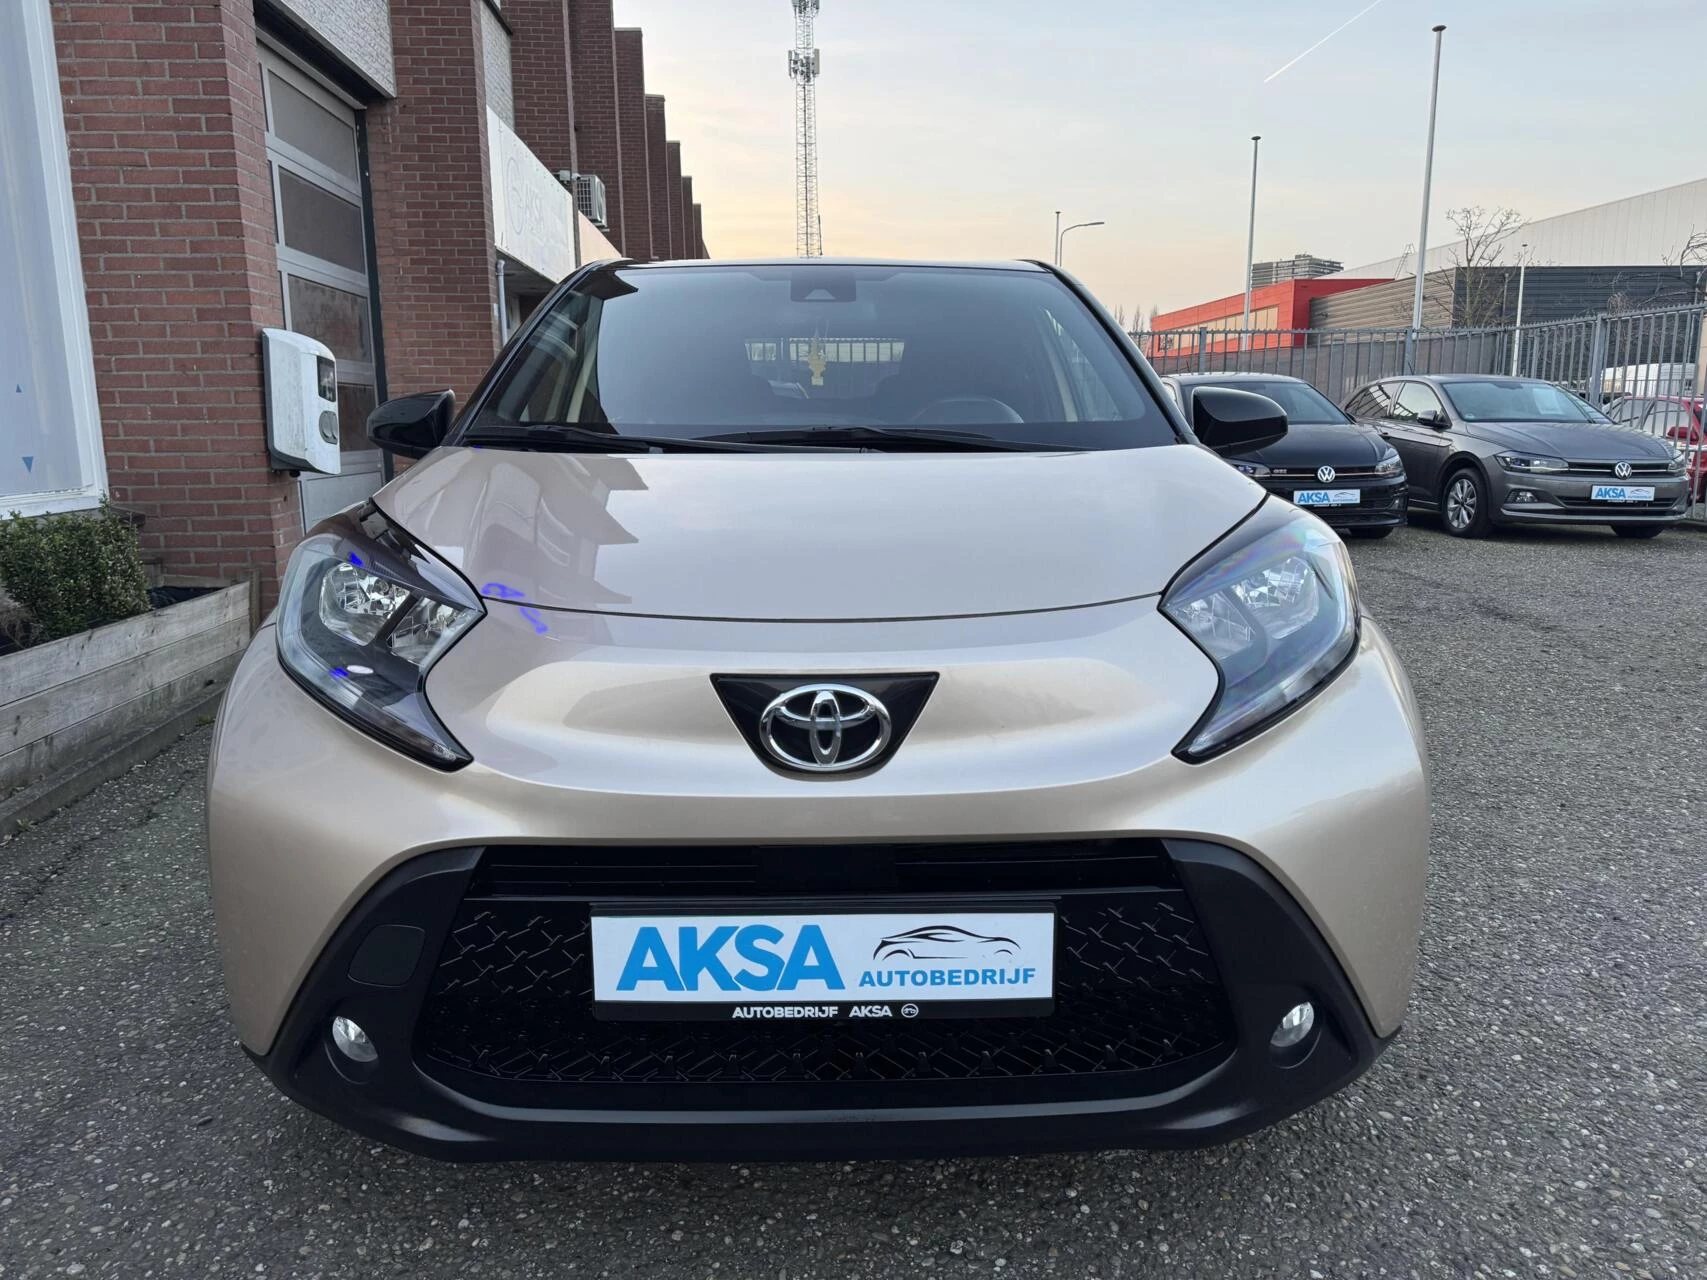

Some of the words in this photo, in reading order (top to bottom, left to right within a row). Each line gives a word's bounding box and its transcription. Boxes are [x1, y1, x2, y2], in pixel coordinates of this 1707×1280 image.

[1297, 492, 1330, 503] AKSA
[1595, 487, 1626, 498] AKSA
[616, 924, 846, 992] AKSA
[858, 967, 1036, 988] AUTOBEDRIJF
[732, 1005, 839, 1019] AUTOBEDRIJF
[848, 1004, 893, 1018] AKSA
